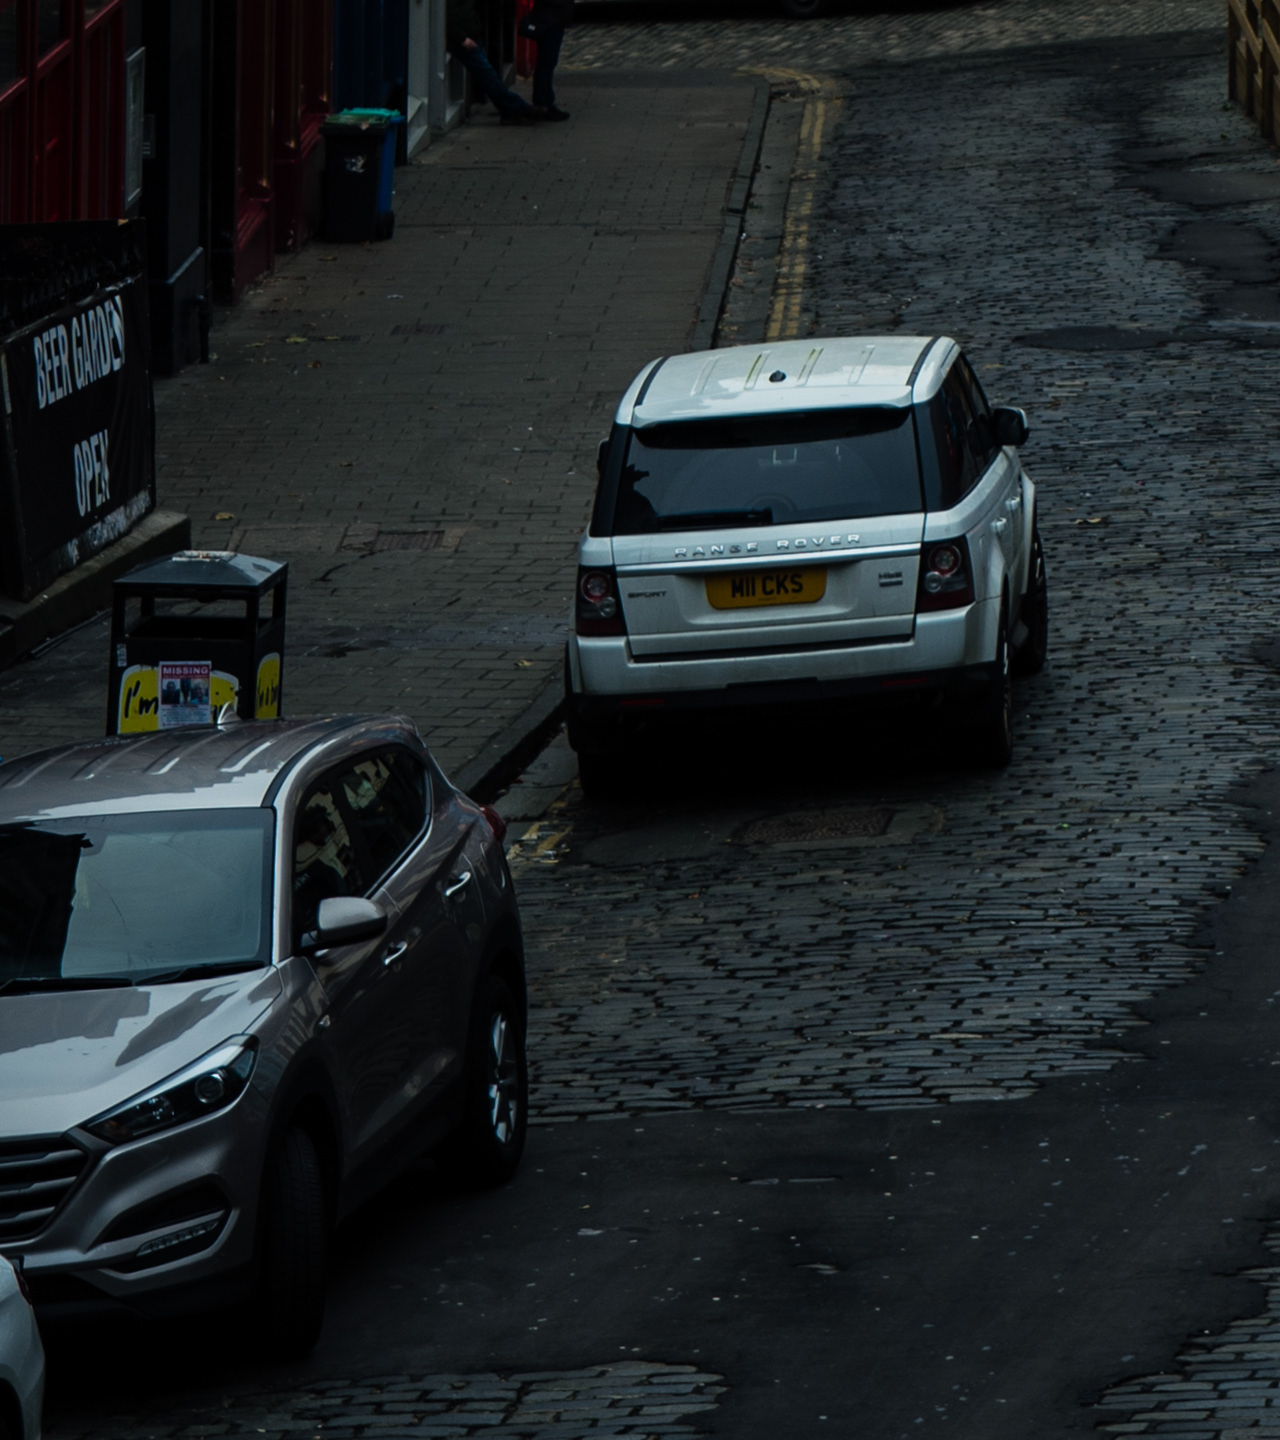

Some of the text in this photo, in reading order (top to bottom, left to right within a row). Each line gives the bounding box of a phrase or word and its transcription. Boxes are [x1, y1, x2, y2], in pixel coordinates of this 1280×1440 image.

[33, 294, 125, 410] BEER GARDEN
[73, 428, 110, 518] OPEN
[675, 534, 860, 558] RANGE ROVER
[762, 573, 803, 595] CKS
[163, 666, 209, 675] MISSING
[124, 680, 159, 719] I'm
